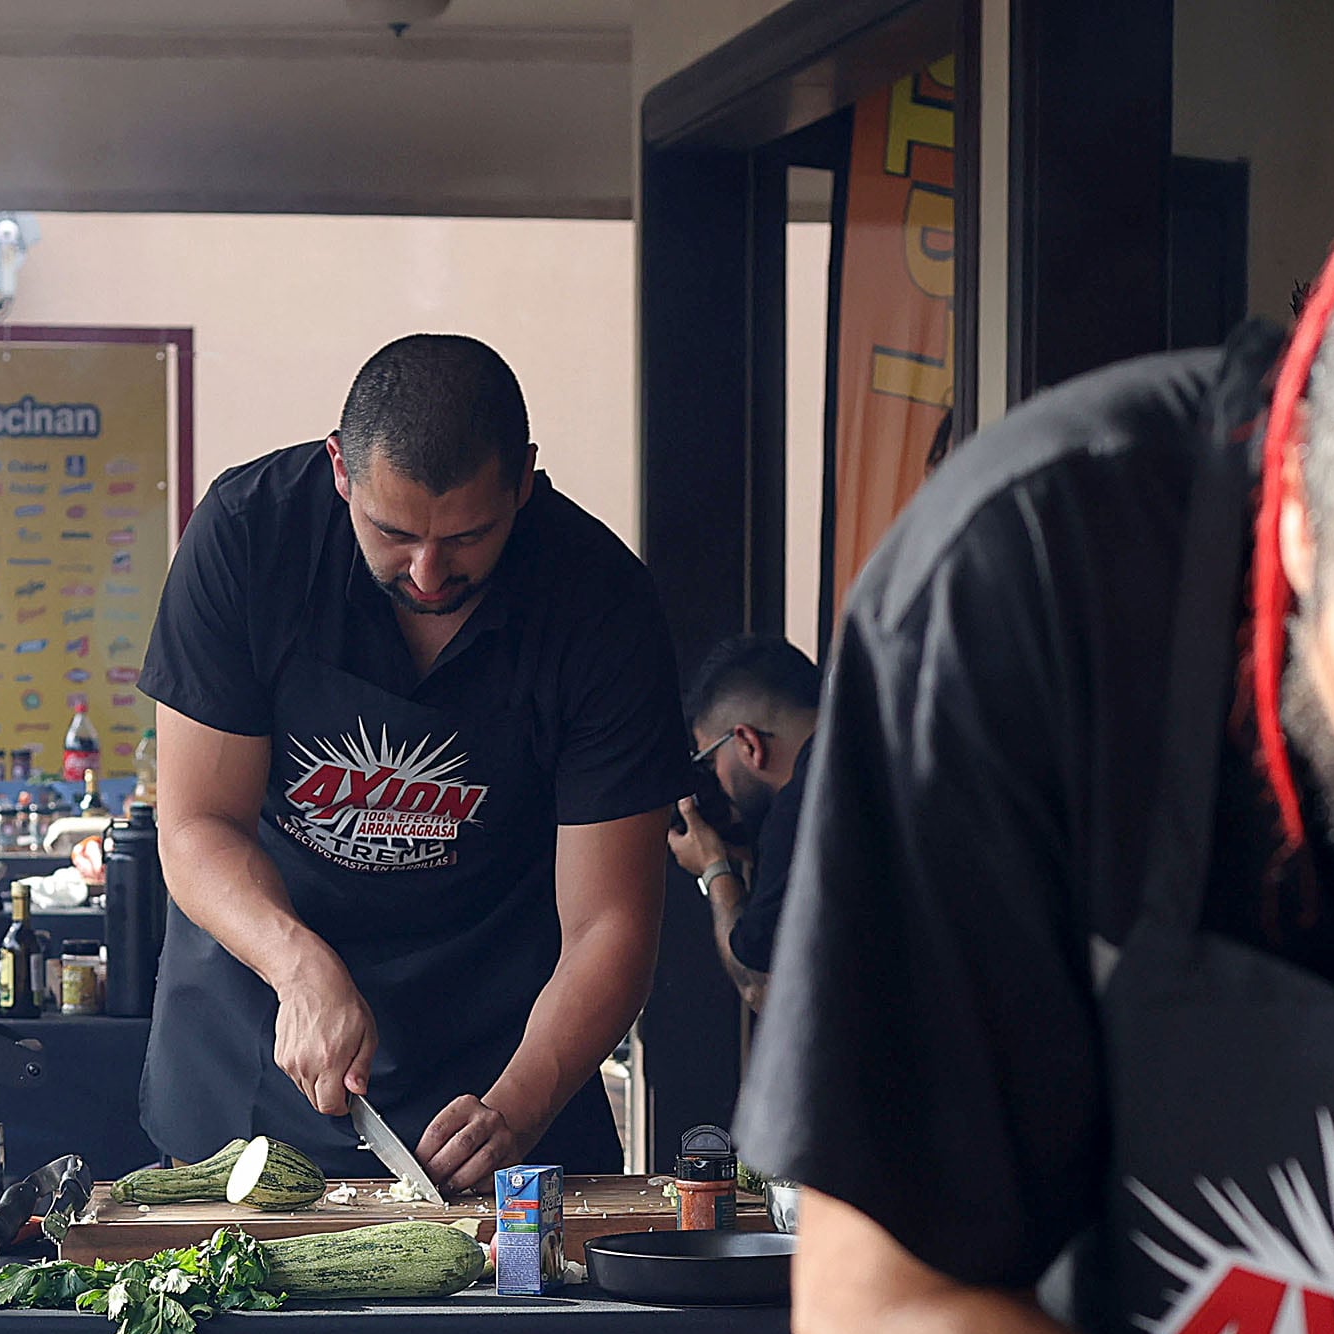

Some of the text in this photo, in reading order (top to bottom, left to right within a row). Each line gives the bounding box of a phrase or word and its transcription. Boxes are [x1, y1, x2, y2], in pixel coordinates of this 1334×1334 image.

[871, 53, 955, 408] LaT
[287, 763, 484, 821] AXION
[356, 822, 455, 838] ARRANCAGRASA
[362, 811, 460, 824] 100% EFECTIVO
[283, 823, 332, 859] EFECTIVO
[333, 856, 371, 872] HASTA
